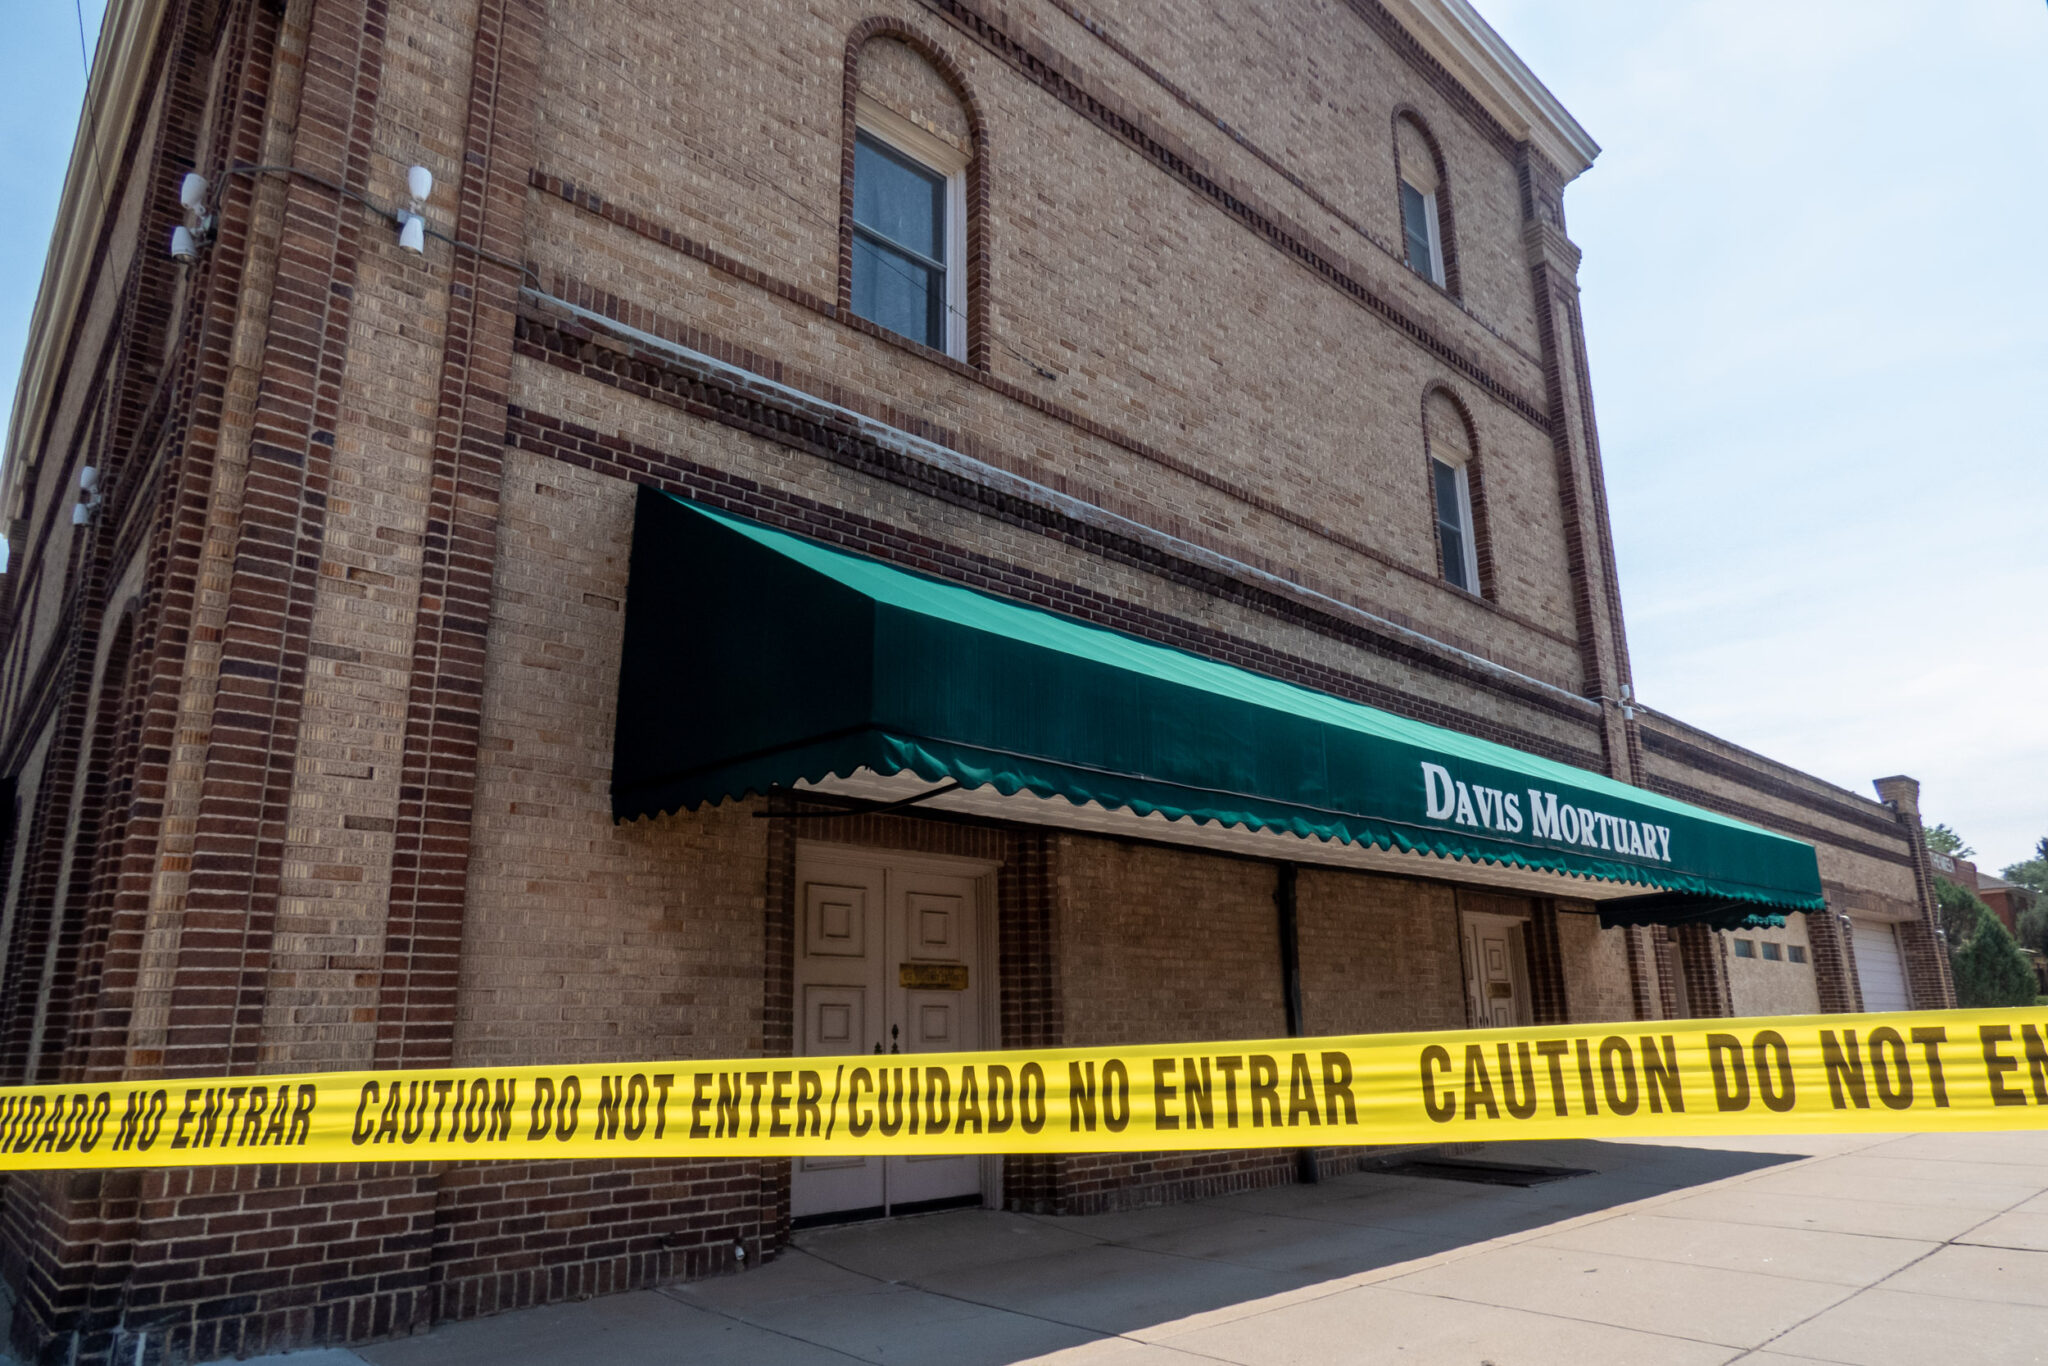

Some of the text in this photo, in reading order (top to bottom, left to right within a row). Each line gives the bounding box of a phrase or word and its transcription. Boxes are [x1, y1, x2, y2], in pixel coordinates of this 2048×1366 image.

[1421, 761, 1672, 863] DAVIS MORTUARY
[112, 1089, 168, 1152] NO
[170, 1083, 317, 1149] ENTRAR
[352, 1077, 517, 1146] CAUTION
[527, 1075, 582, 1142] DO
[594, 1073, 675, 1140] NOT
[689, 1061, 1046, 1140] ENTER/CUIDADO
[1068, 1058, 1130, 1132] NO
[1152, 1051, 1358, 1130] ENTRAR
[1420, 1035, 1685, 1123] CAUTION
[1706, 1030, 1796, 1113] DO
[1819, 1026, 1950, 1110] NOT
